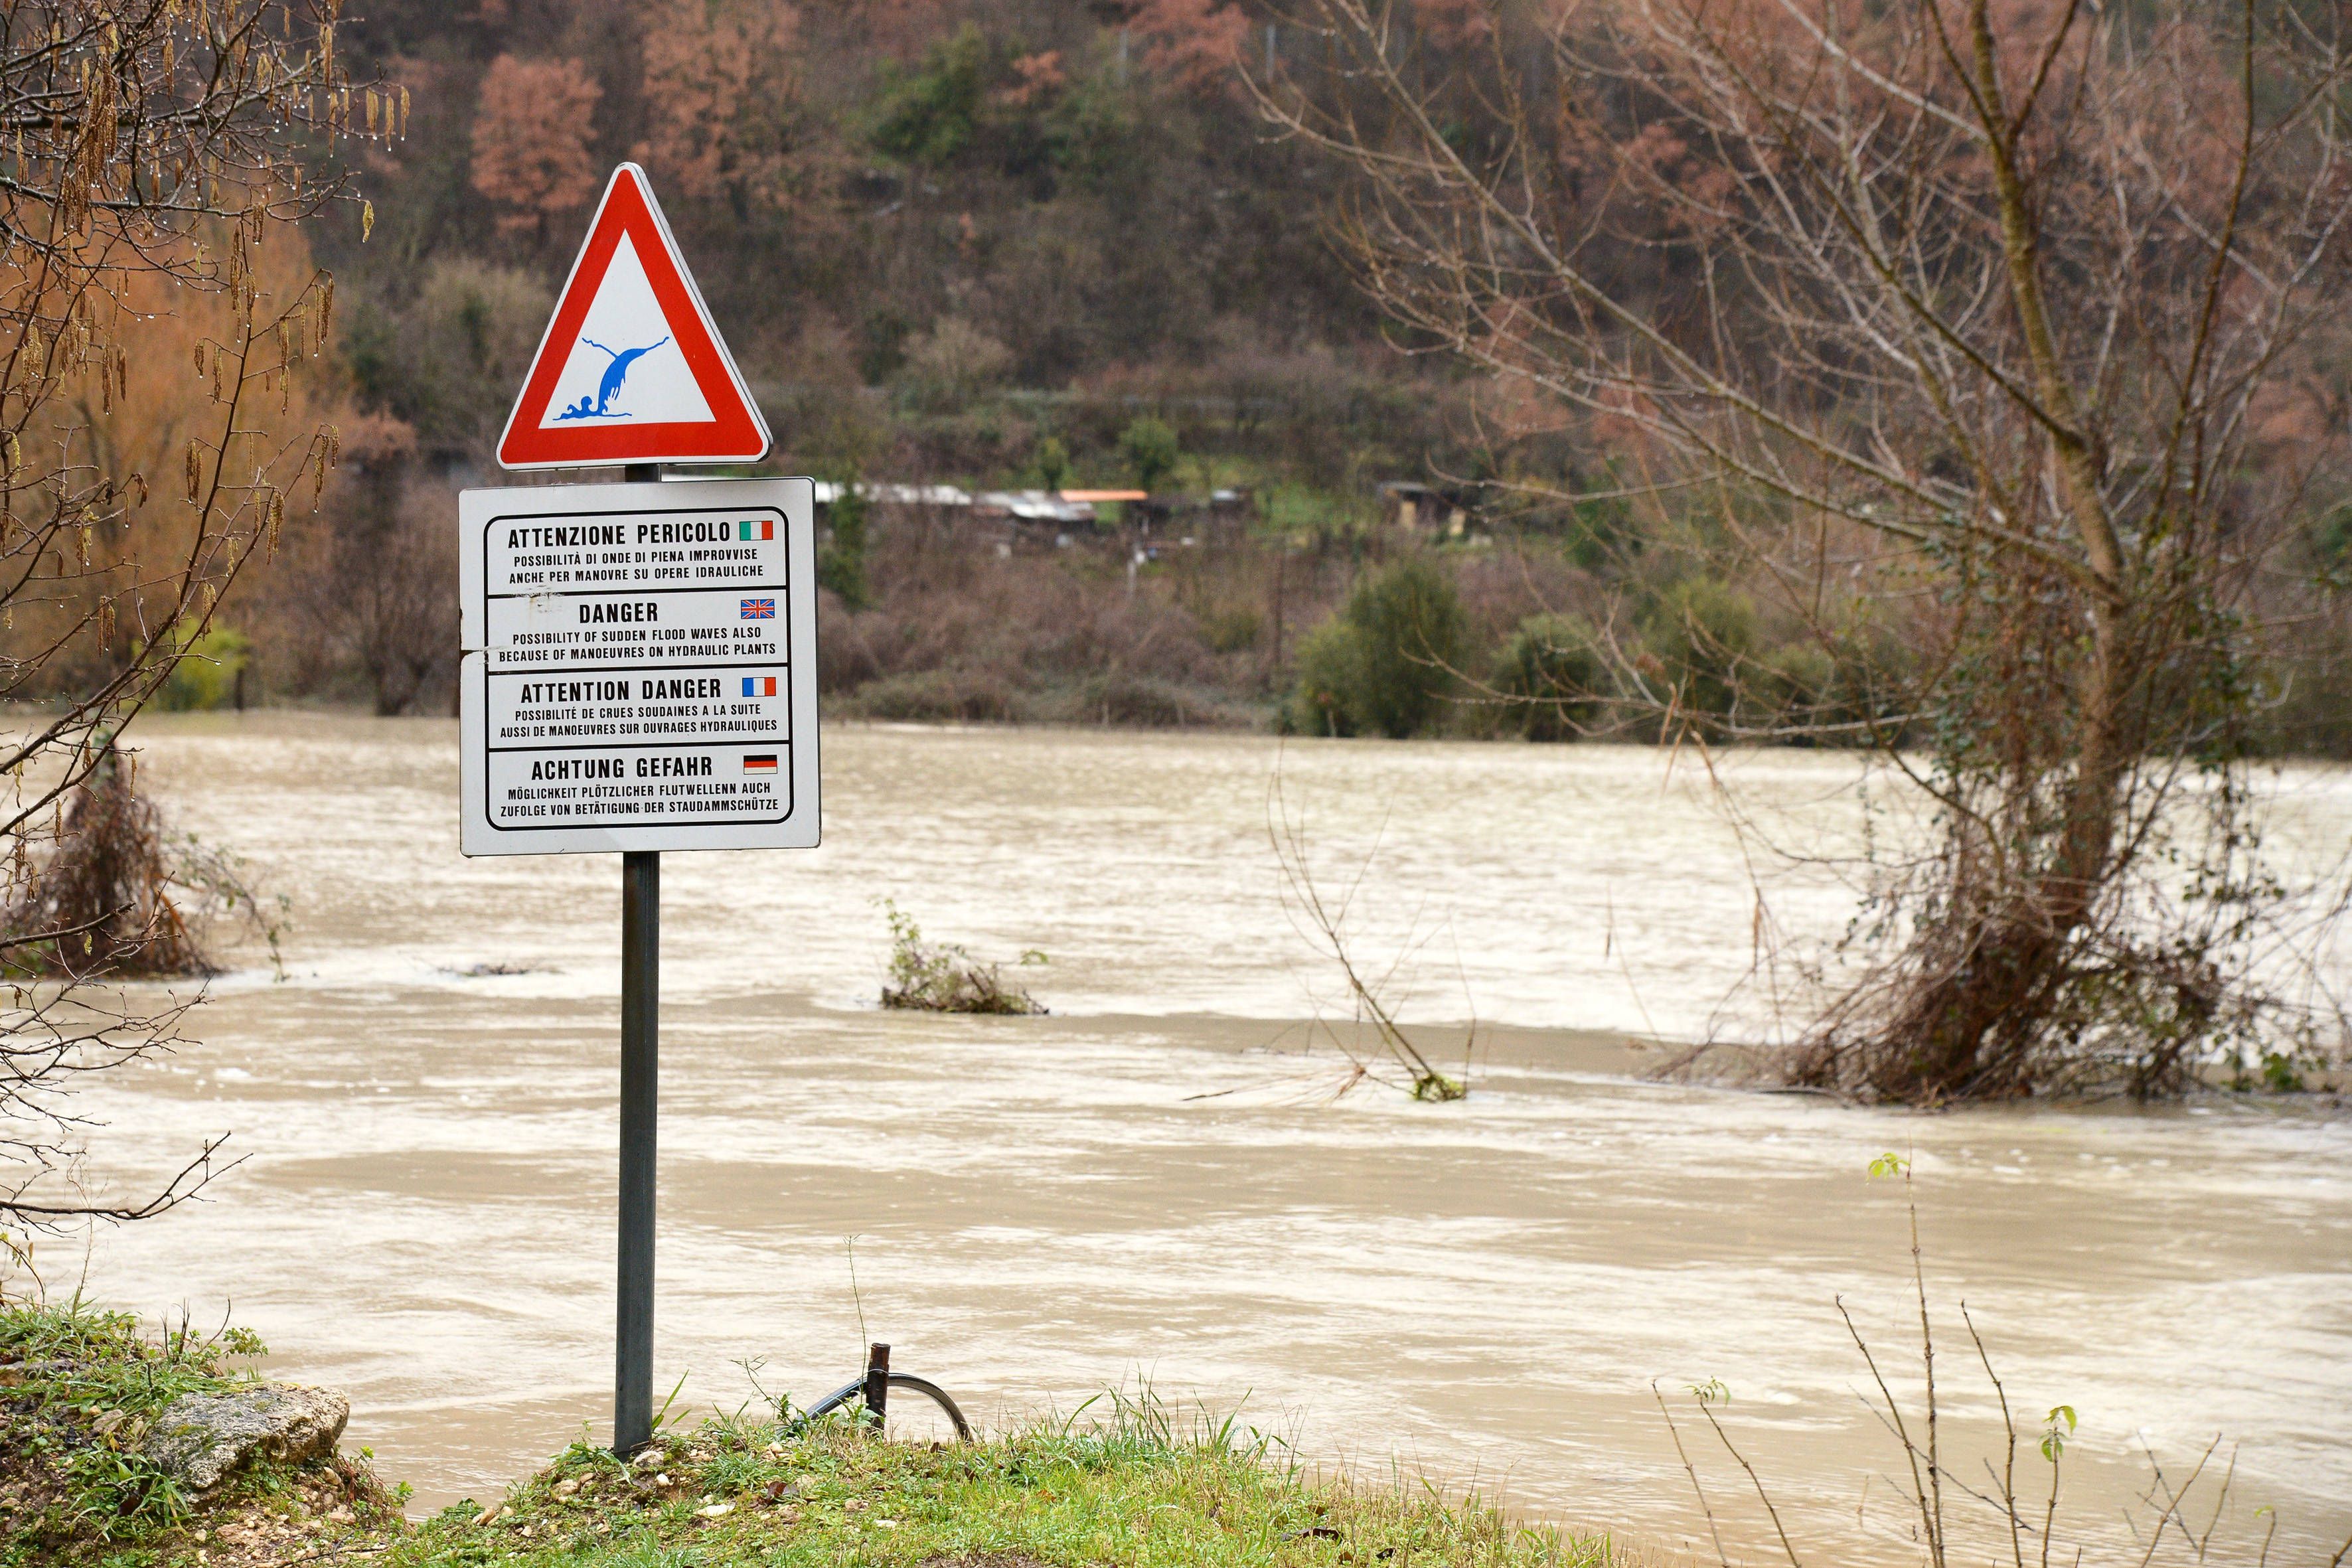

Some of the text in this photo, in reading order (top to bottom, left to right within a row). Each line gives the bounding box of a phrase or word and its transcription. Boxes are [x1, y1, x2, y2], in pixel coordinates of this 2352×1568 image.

[508, 522, 730, 549] ATTENZIONE PERICOLO
[514, 548, 757, 568] POSSIBILITÀ DI ONDE DI PIENA IMPROVVISE
[509, 565, 763, 584] ANCHE PER MANOVRE SU OPERE IDRAULICHE
[579, 602, 658, 624] DANGER
[512, 627, 761, 645] POSSIBILITY OF SUDDEN FLOOD WAVES ALSO
[499, 643, 775, 663] BECAUSE OF MANOEUVRES ON HYDRAULIC PLANTS
[520, 678, 721, 704] ATTENTION DANGER
[515, 704, 761, 722] POSSIBILITÉ DE CRUES SOUDAINES A LA SUITE
[500, 720, 777, 738] AUSSI DE MANOEUVRES SUR OUVRAGES HYDRAULIQUES
[531, 756, 712, 781] ACHTUNG GEFAHR
[508, 782, 770, 800] MÖGLICHKEIT PLÖTZLICHER FLUTWELLENN AUCH
[501, 797, 779, 817] ZUFOLGE VON BETÄTIGUNG DER STAUDAMMSCHÜTZE
